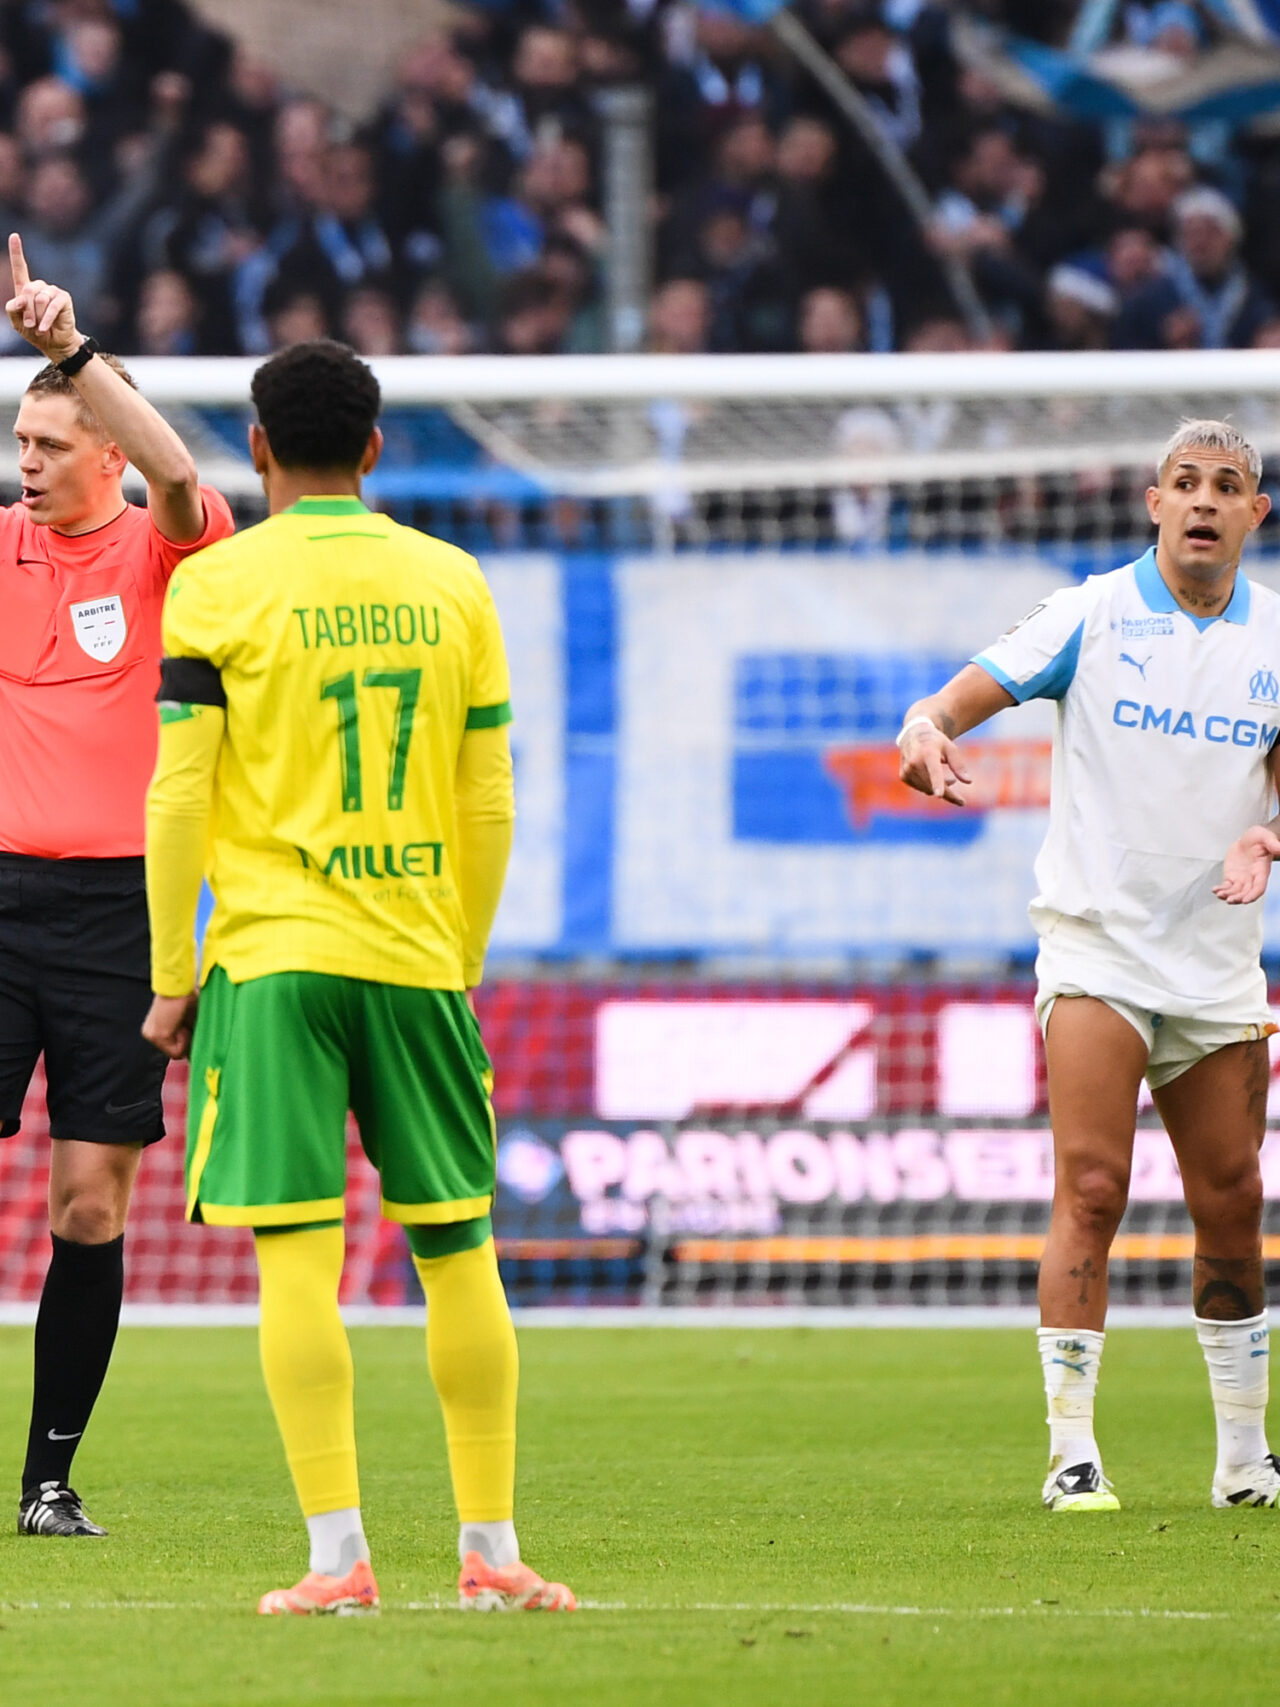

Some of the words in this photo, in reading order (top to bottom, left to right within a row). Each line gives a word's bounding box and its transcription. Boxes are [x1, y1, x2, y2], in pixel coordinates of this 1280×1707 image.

[78, 603, 116, 618] ARBITRE
[293, 604, 441, 649] TABIBOU
[320, 667, 423, 813] 17
[1113, 699, 1197, 739] CMA
[1204, 715, 1279, 751] CGM
